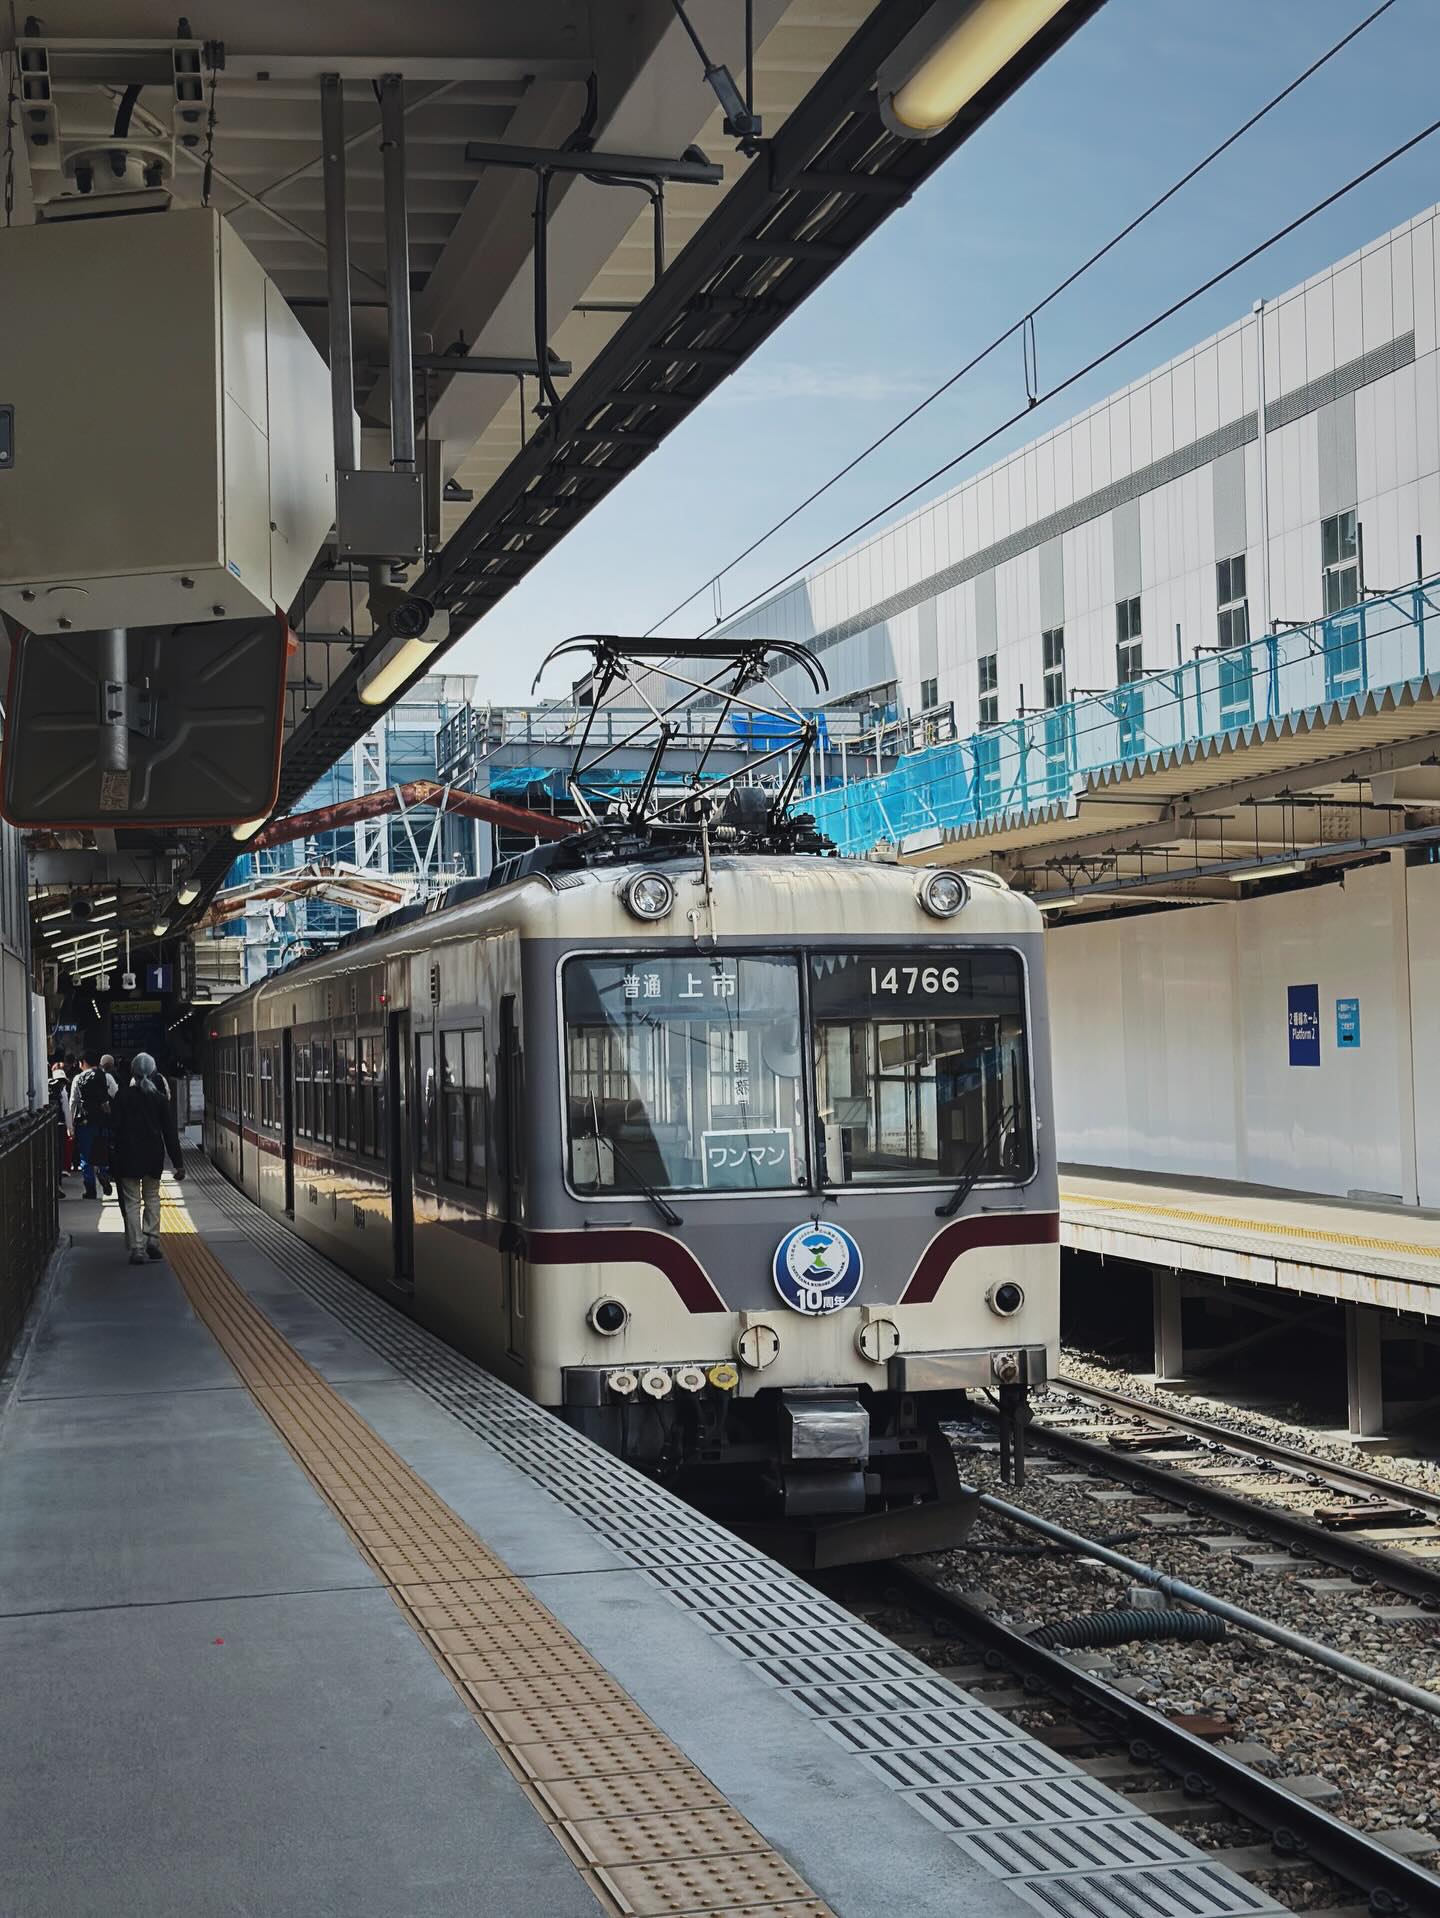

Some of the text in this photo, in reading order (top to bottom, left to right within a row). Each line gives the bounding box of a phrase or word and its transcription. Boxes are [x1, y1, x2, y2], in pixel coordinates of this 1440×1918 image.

[153, 967, 163, 989] 1
[623, 974, 661, 998] 普通
[870, 967, 960, 994] 14766
[1292, 1028, 1315, 1040] Platform 2
[709, 1146, 785, 1167] ワンマン
